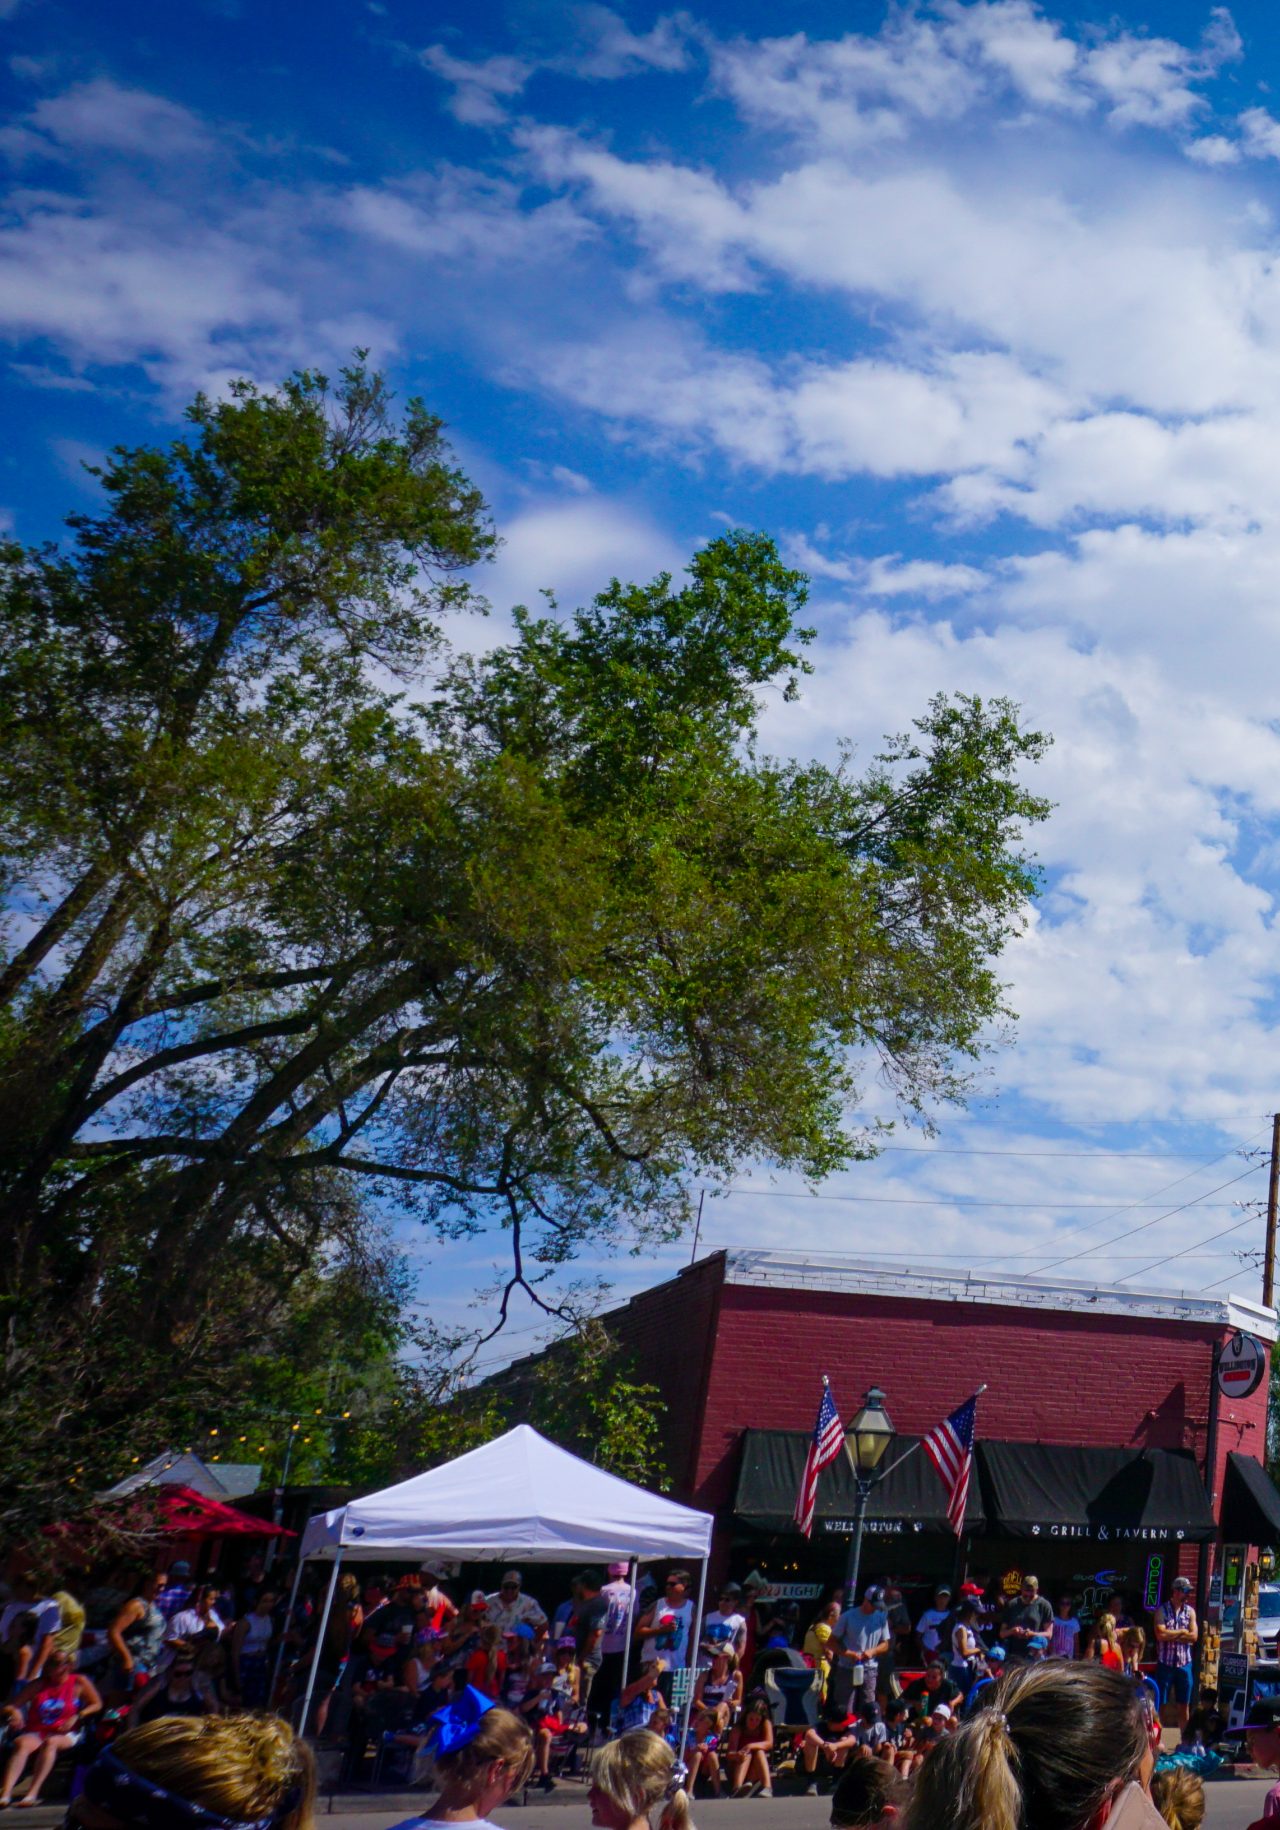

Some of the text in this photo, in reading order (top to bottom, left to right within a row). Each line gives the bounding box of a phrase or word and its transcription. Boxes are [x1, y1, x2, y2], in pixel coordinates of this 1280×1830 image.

[824, 1520, 902, 1532] WELLNGTON
[1050, 1525, 1168, 1540] GRILL & TAVERN
[1147, 1556, 1162, 1606] OPEN
